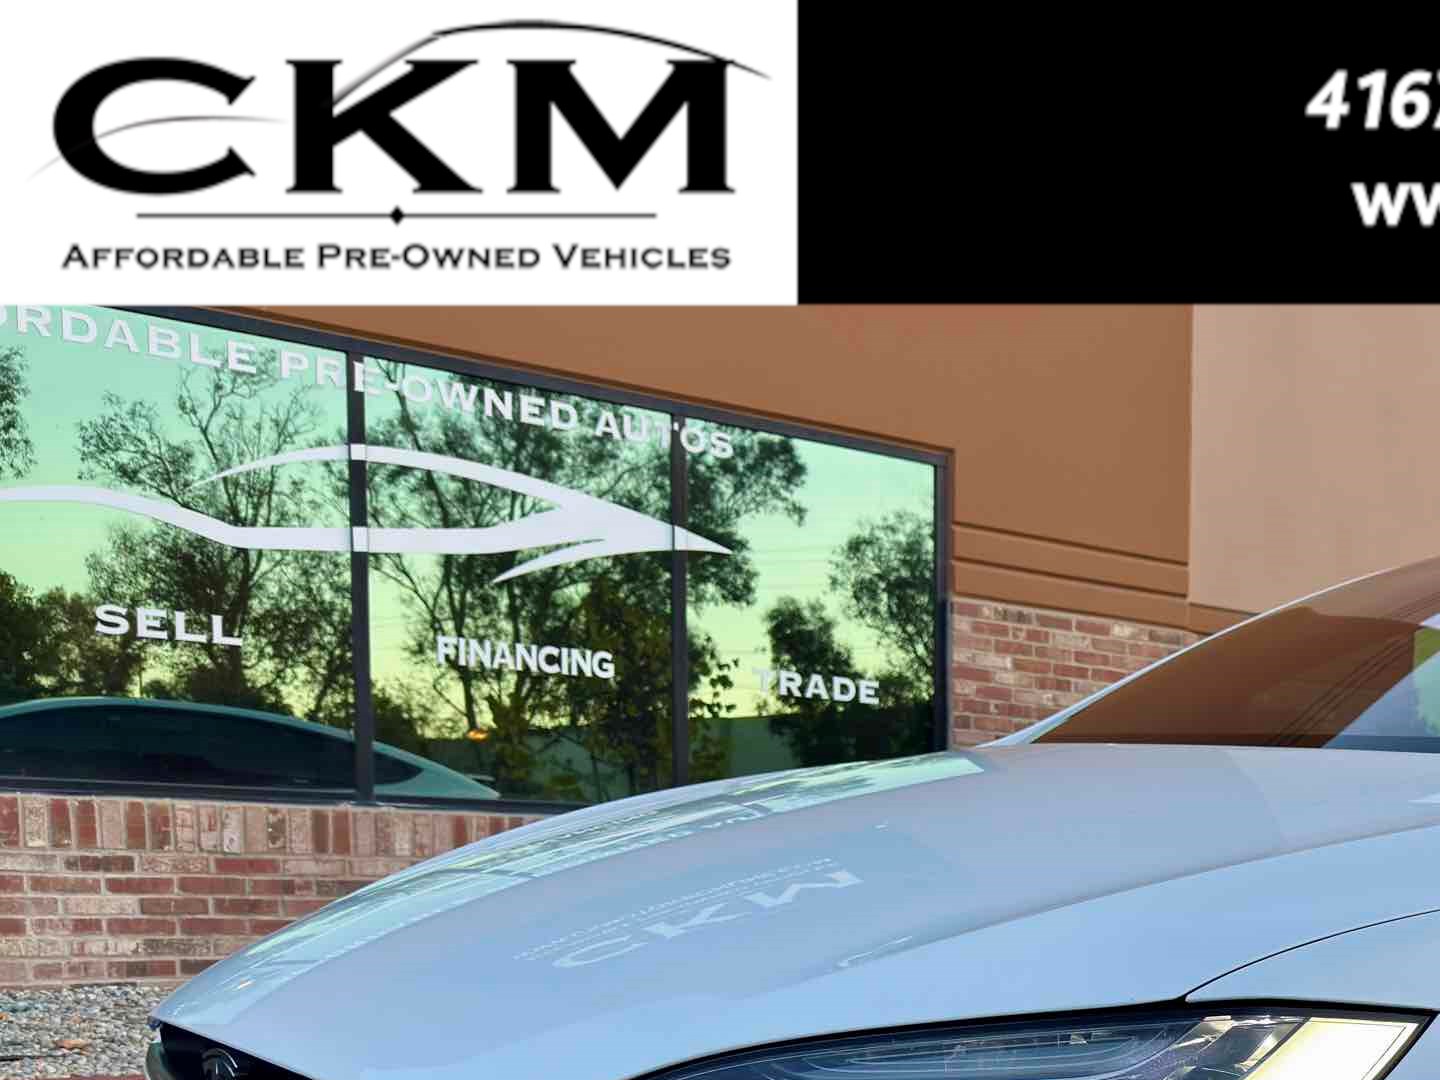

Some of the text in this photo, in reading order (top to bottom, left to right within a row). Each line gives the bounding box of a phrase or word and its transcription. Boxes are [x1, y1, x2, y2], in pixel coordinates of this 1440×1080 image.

[280, 350, 578, 431] PRE-OWNED
[595, 413, 734, 459] AUTOS
[96, 604, 243, 647] SELL
[437, 635, 615, 680] FINANCING
[752, 667, 880, 705] TRADE
